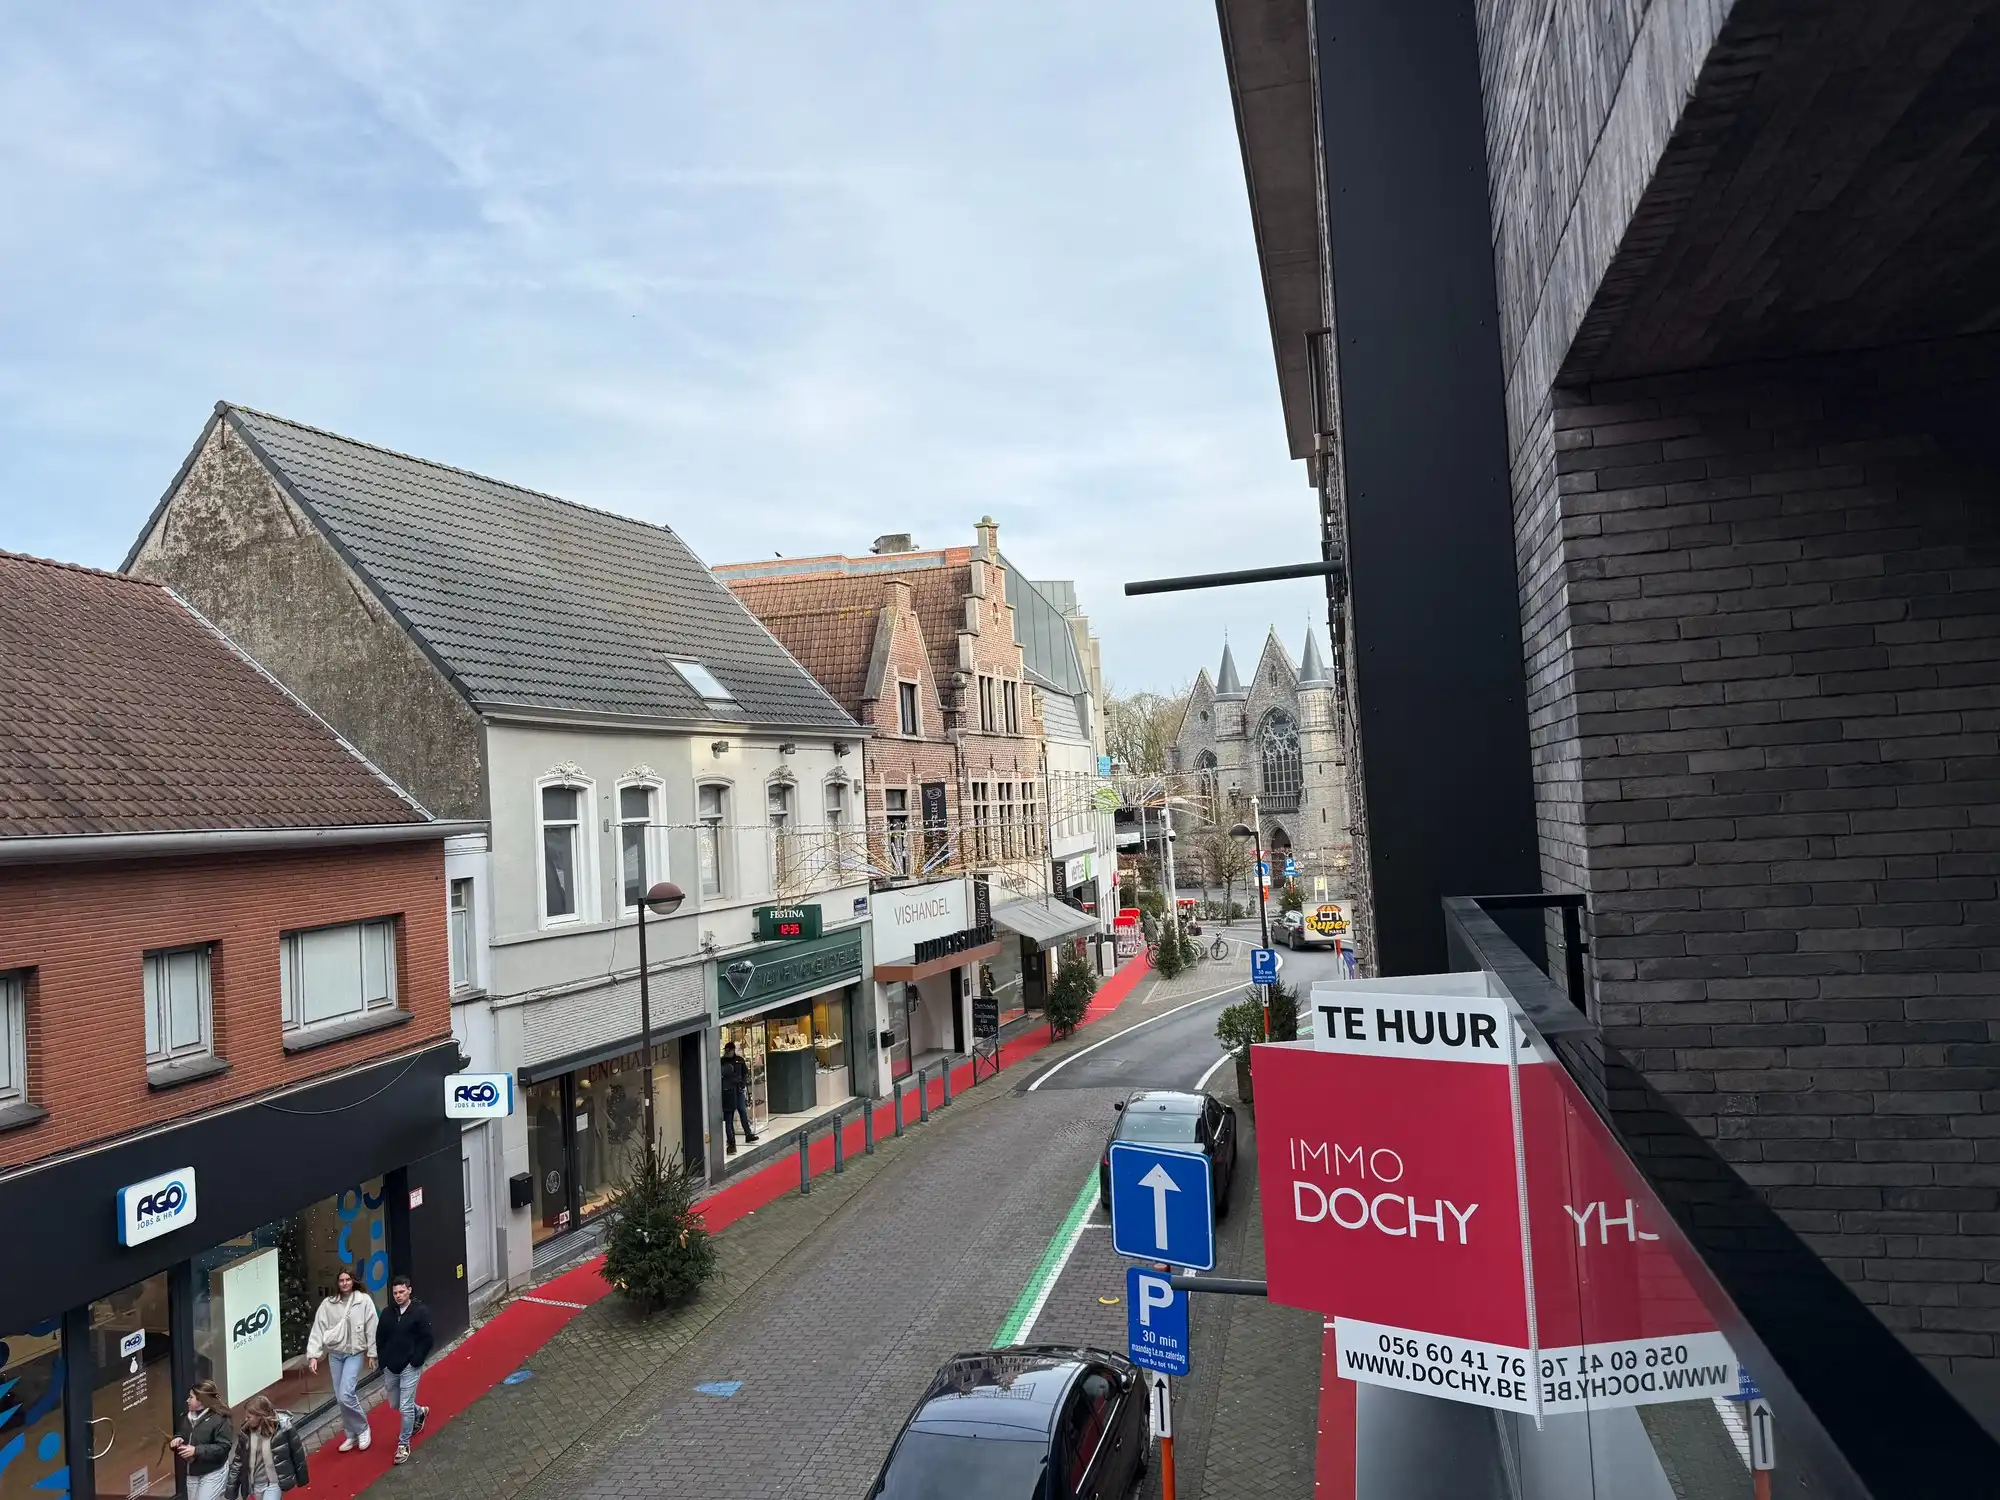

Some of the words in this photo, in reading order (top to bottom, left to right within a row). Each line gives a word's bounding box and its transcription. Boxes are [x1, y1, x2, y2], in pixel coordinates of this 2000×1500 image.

[893, 897, 951, 925] VISHANDEL
[977, 874, 989, 928] Mayerlin
[770, 909, 805, 919] FESTINA
[1305, 915, 1350, 934] Super
[780, 923, 800, 935] 12:35
[1255, 951, 1270, 970] P
[1318, 1005, 1366, 1041] TE
[1376, 1008, 1500, 1049] HUUR
[588, 1043, 670, 1083] ENCHATE
[454, 1082, 498, 1103] AGO
[1289, 1137, 1404, 1183] IMMO
[137, 1182, 185, 1222] AGO
[1293, 1180, 1479, 1245] DOCHY
[137, 1217, 154, 1230] JOBS
[156, 1214, 161, 1223] &
[163, 1210, 173, 1220] HR
[1139, 1274, 1174, 1327] P
[233, 1305, 271, 1343] AGO
[124, 1333, 142, 1350] AGO
[233, 1340, 247, 1350] JOBS
[254, 1330, 262, 1338] HR
[1142, 1329, 1156, 1344] 30
[1159, 1335, 1178, 1349] min
[1131, 1343, 1152, 1358] maandag
[1165, 1350, 1186, 1365] zaterdag
[1138, 1356, 1149, 1364] van
[1149, 1358, 1157, 1366] 9u
[1167, 1362, 1178, 1371] 18u
[1378, 1334, 1419, 1358] 056
[1426, 1343, 1453, 1364] 60
[1460, 1349, 1489, 1371] 41
[1496, 1354, 1526, 1377] 76
[1345, 1349, 1528, 1402] WWW.DOCHY.BE
